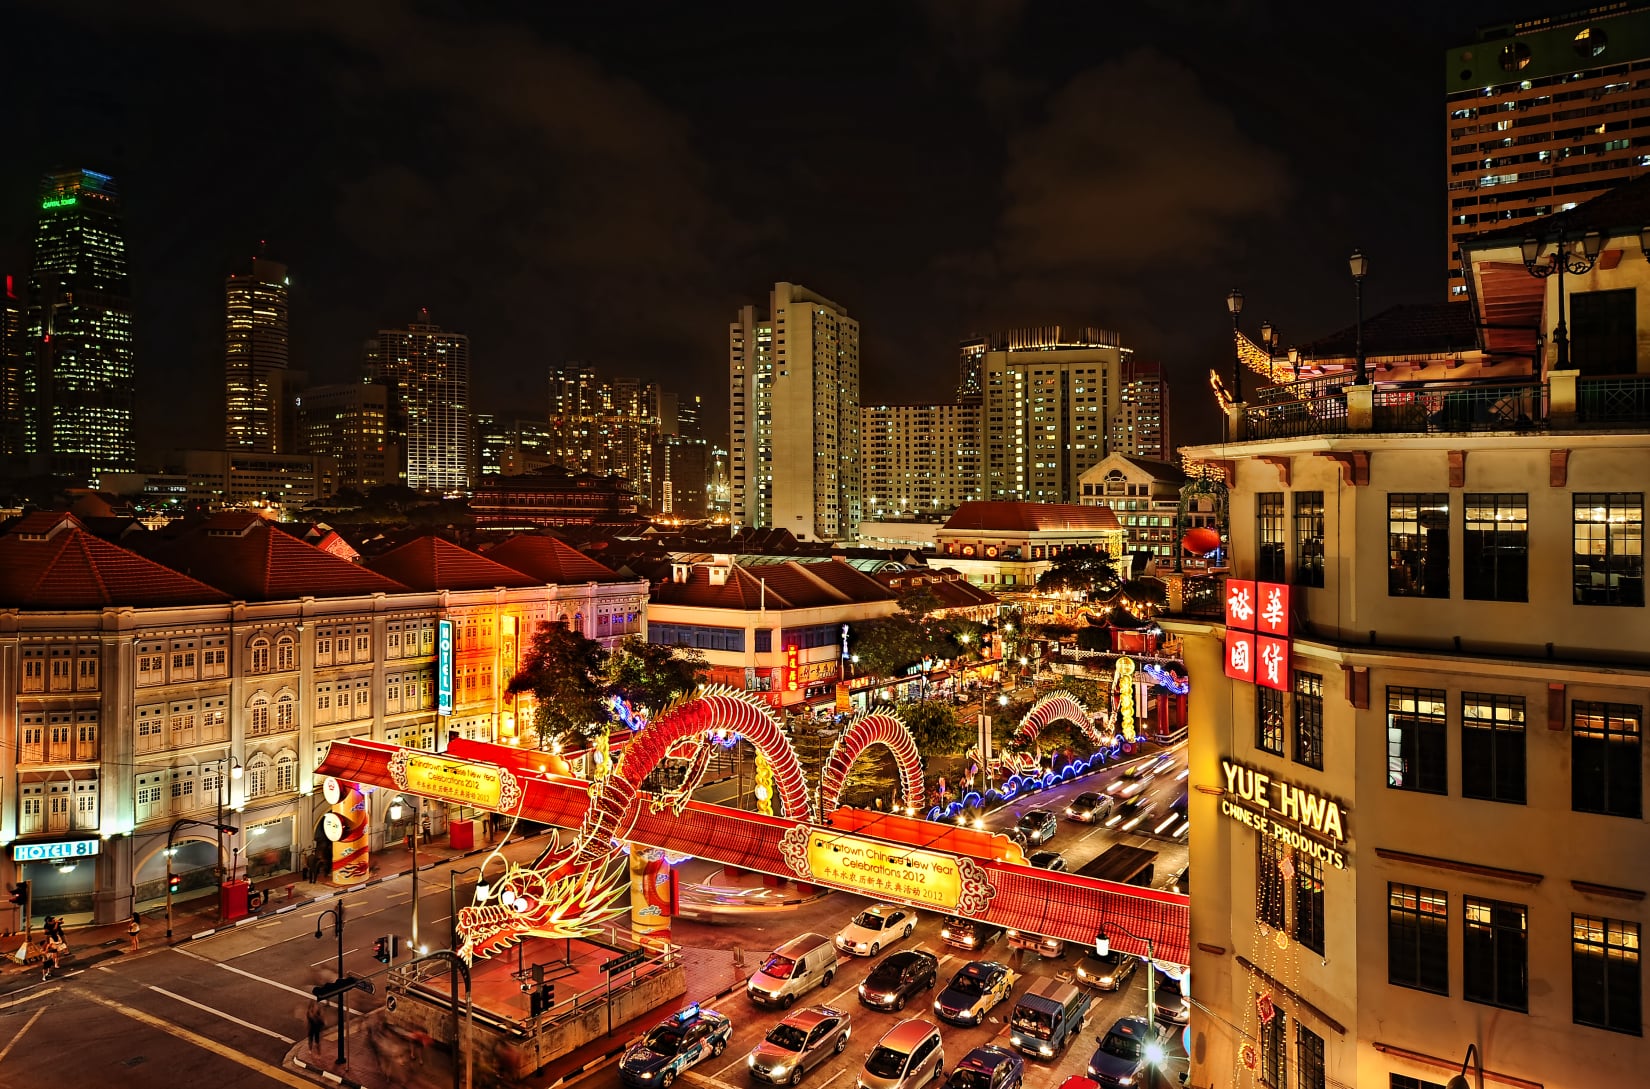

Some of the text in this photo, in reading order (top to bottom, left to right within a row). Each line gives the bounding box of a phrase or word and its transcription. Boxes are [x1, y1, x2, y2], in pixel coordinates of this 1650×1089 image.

[1228, 587, 1284, 630] 裕華
[440, 627, 451, 707] HOTEL 81
[428, 772, 479, 790] Celebrations 2012
[483, 772, 496, 782] Year
[477, 793, 489, 803] 2012
[1223, 761, 1343, 841] YUE HWA
[1222, 800, 1344, 870] CHINESE PRODUCTS
[18, 842, 93, 860] HOTEL 81
[866, 849, 904, 866] Chinese
[906, 857, 929, 871] New
[931, 861, 954, 876] Year
[842, 857, 926, 884] Celebrations 2012
[923, 889, 943, 902] 2012
